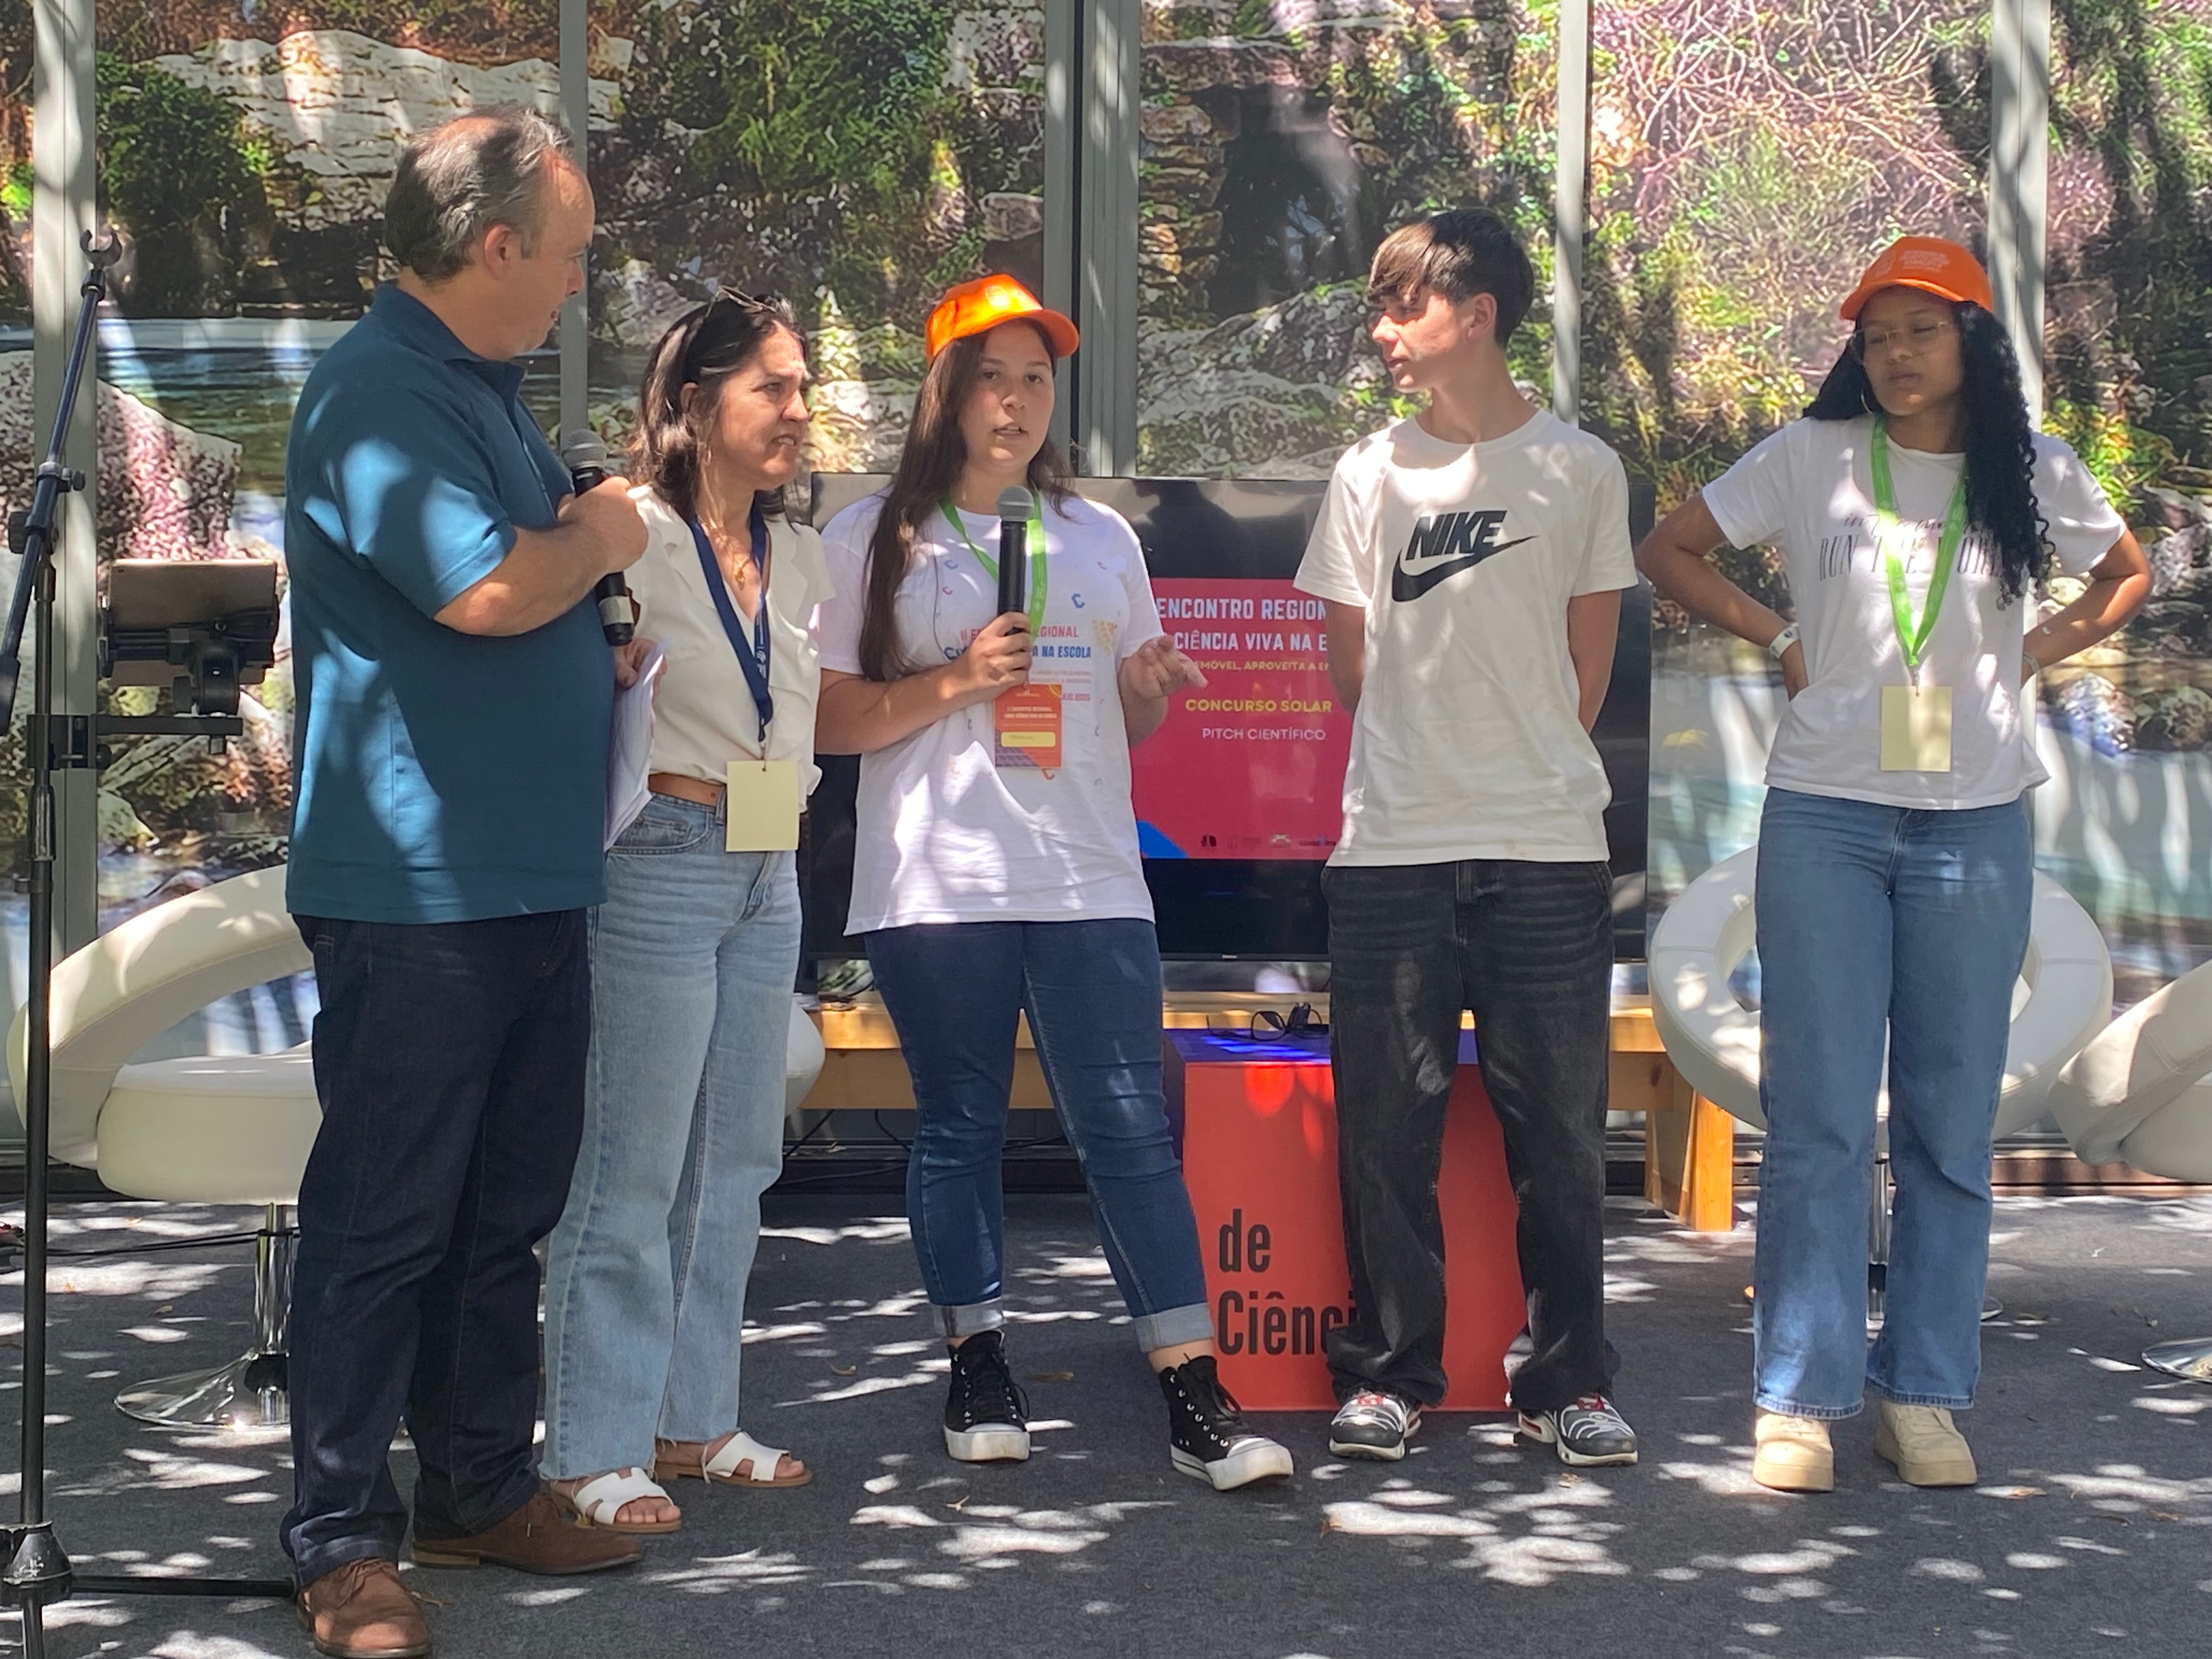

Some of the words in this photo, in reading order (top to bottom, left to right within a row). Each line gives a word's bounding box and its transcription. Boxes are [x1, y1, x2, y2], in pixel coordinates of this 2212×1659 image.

[1405, 510, 1508, 561] NIKE
[1155, 597, 1254, 619] ENCONTRO
[1261, 598, 1326, 620] REGION
[1037, 625, 1079, 637] GIONAL
[1175, 629, 1239, 651] CIÊNCIA
[1245, 633, 1284, 651] VIVA
[1290, 633, 1312, 651] NA
[1041, 645, 1054, 658] NA
[1058, 646, 1091, 658] ESCOLA
[1195, 659, 1242, 672] MÓVEL,
[1244, 661, 1305, 671] APROVEITA
[1308, 662, 1316, 671] A
[1185, 699, 1277, 712] CONCURSO
[1280, 700, 1332, 713] SOLAR
[1202, 727, 1244, 740] PITCH
[1247, 727, 1326, 741] CIENTÍFICO
[1218, 1209, 1271, 1273] de
[1217, 1290, 1357, 1355] Ciênc
